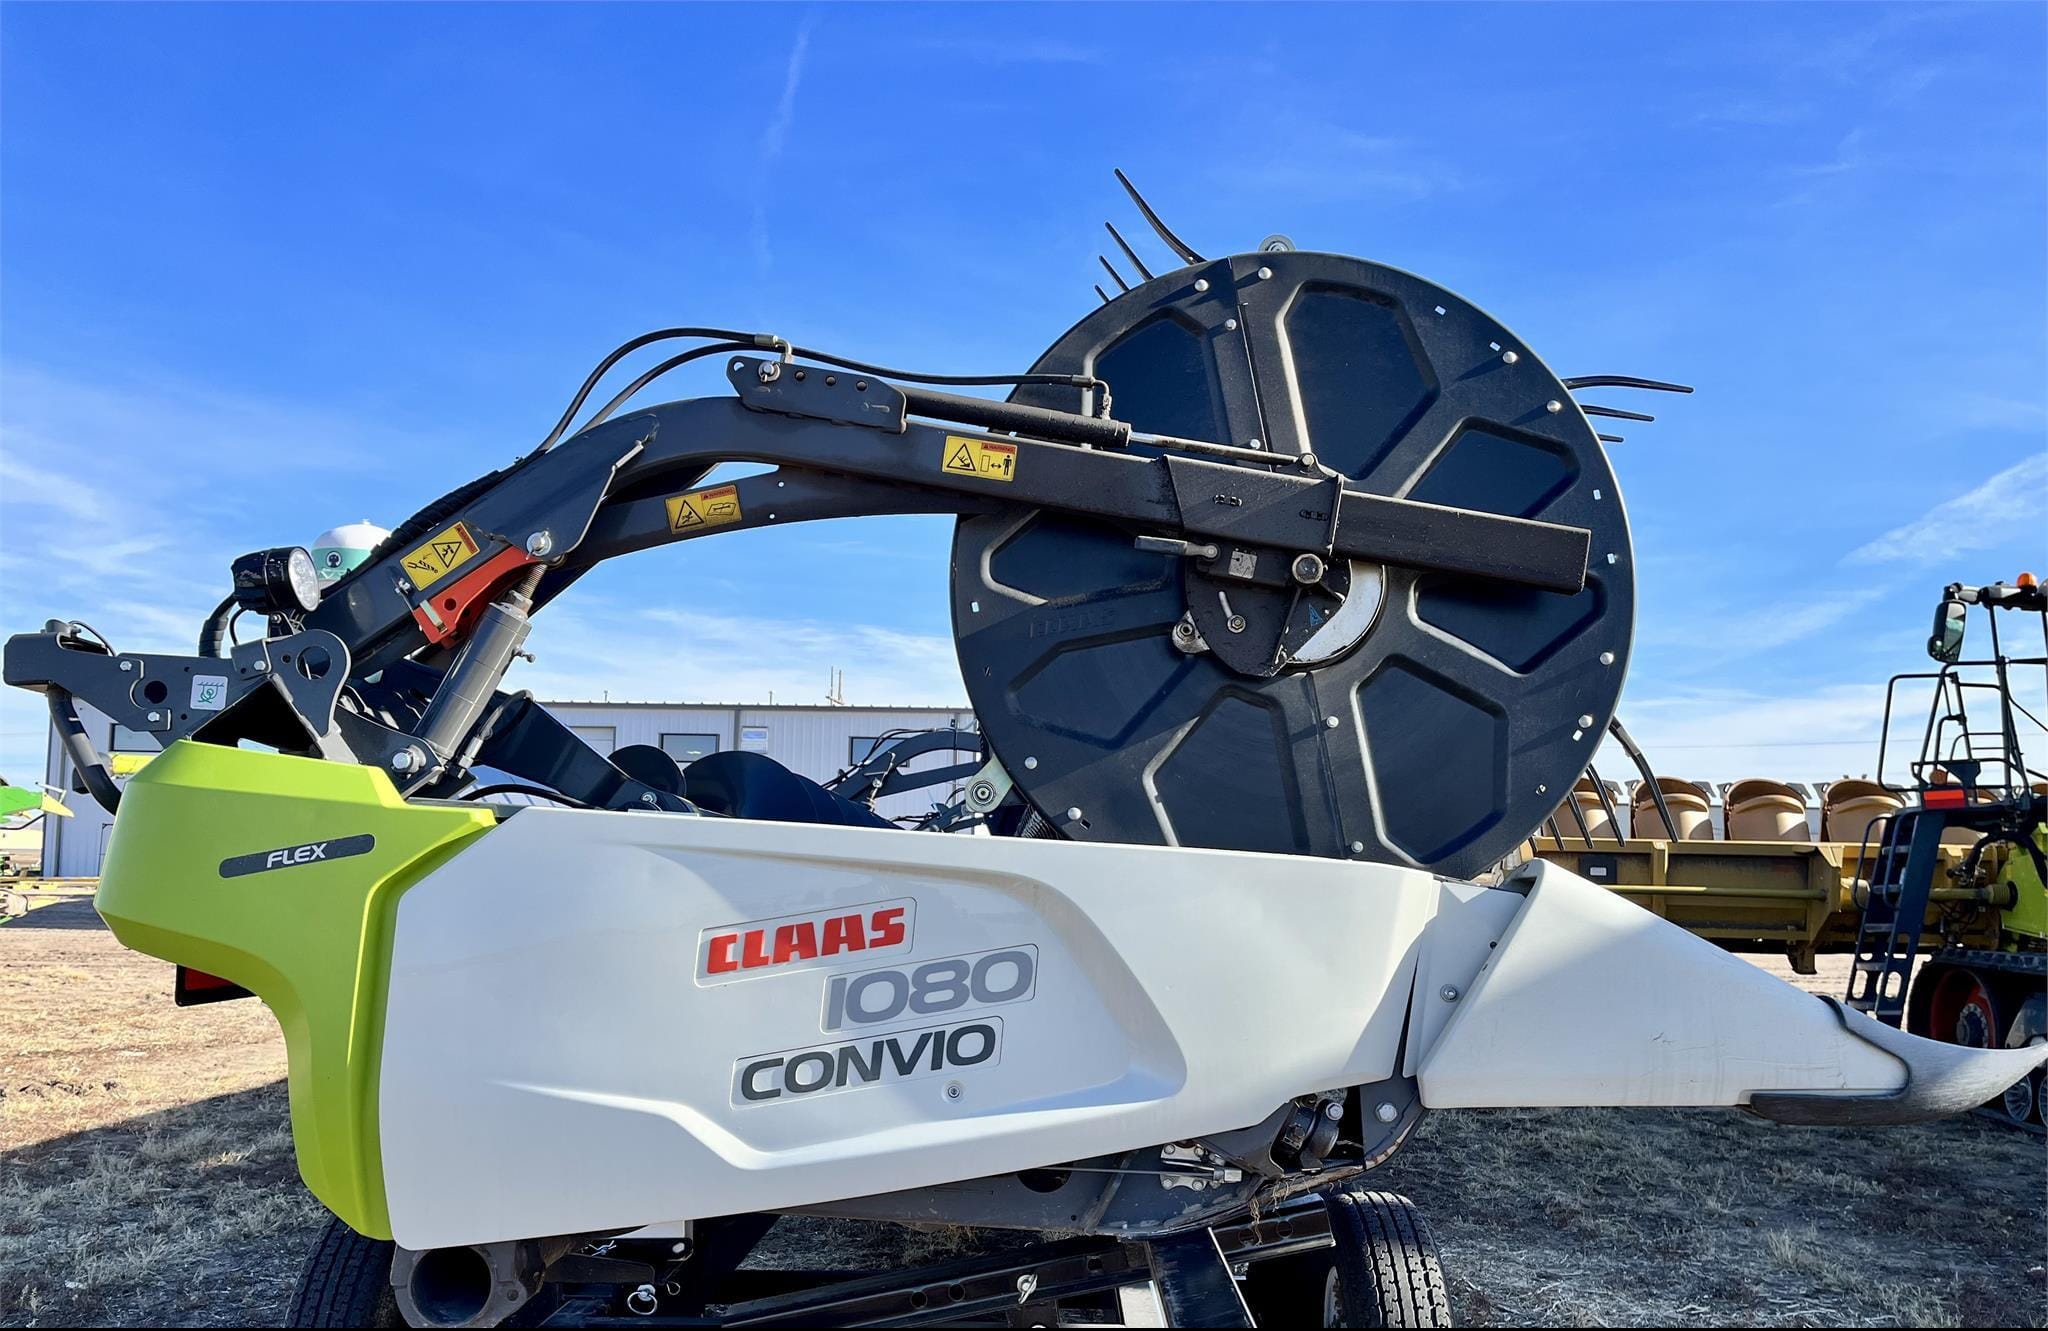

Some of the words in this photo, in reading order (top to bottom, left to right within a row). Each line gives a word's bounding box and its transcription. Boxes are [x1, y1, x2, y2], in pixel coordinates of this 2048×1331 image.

[266, 843, 328, 869] FLEX
[706, 907, 905, 974] CLAAS
[826, 950, 1034, 1030] 1080
[740, 1024, 996, 1101] CONVIO
